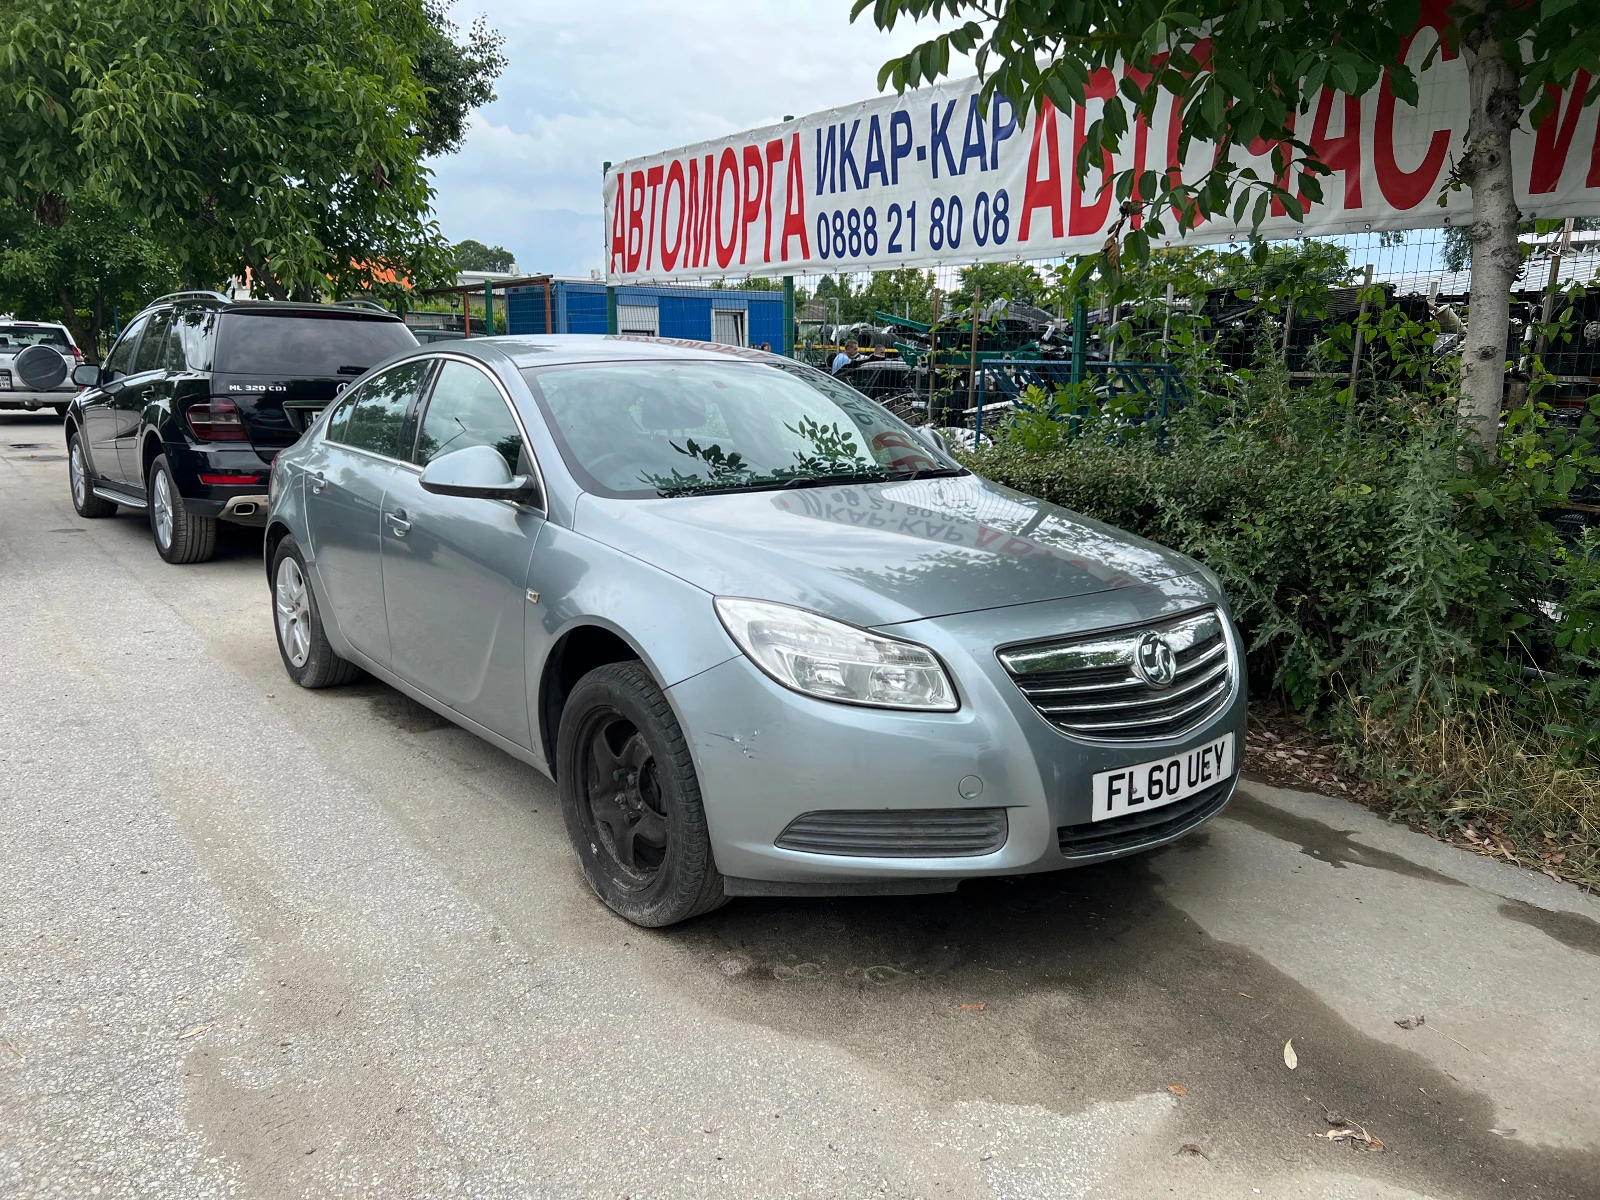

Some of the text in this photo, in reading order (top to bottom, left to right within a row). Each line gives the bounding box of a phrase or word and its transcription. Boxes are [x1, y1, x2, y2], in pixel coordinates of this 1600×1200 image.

[816, 90, 1017, 196] ИКАР-КАР
[610, 133, 810, 274] АВТОМОРГА
[817, 189, 1010, 260] 0888 21 80 08
[1107, 741, 1226, 812] FL60 UEY
